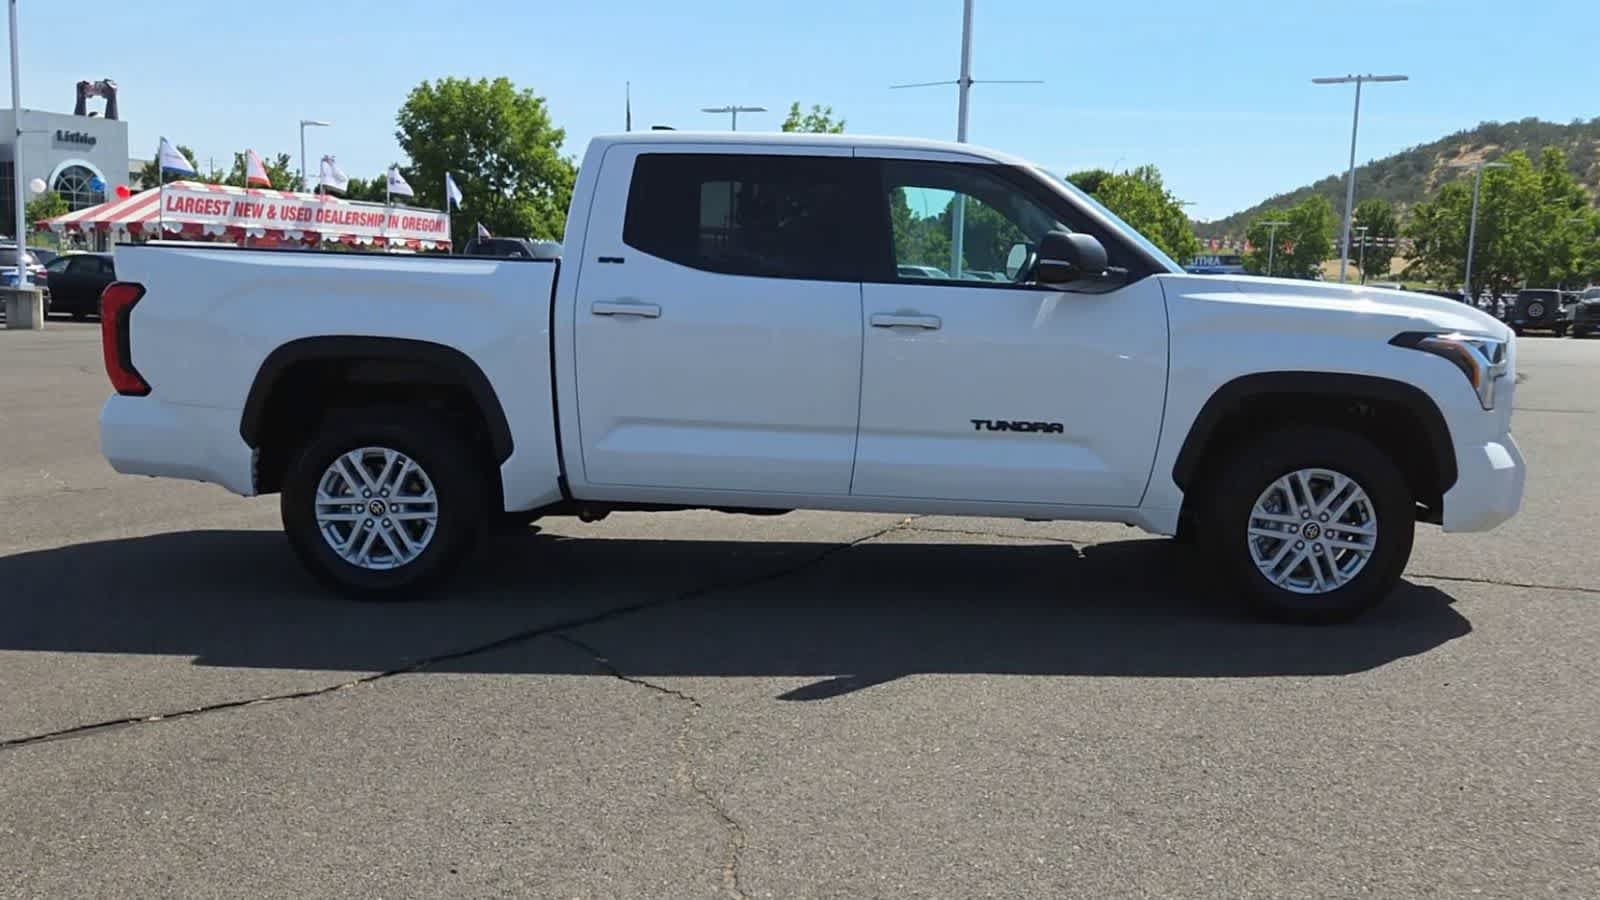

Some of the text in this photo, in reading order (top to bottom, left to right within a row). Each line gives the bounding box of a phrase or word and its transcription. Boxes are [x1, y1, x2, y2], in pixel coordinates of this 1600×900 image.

[166, 195, 230, 216] LARGEST
[233, 201, 264, 218] NEW
[266, 203, 277, 219] &
[280, 205, 312, 221] USED
[315, 207, 385, 228] DEALERSHIP
[387, 214, 399, 228] IN
[970, 418, 1064, 434] TUNDRA
